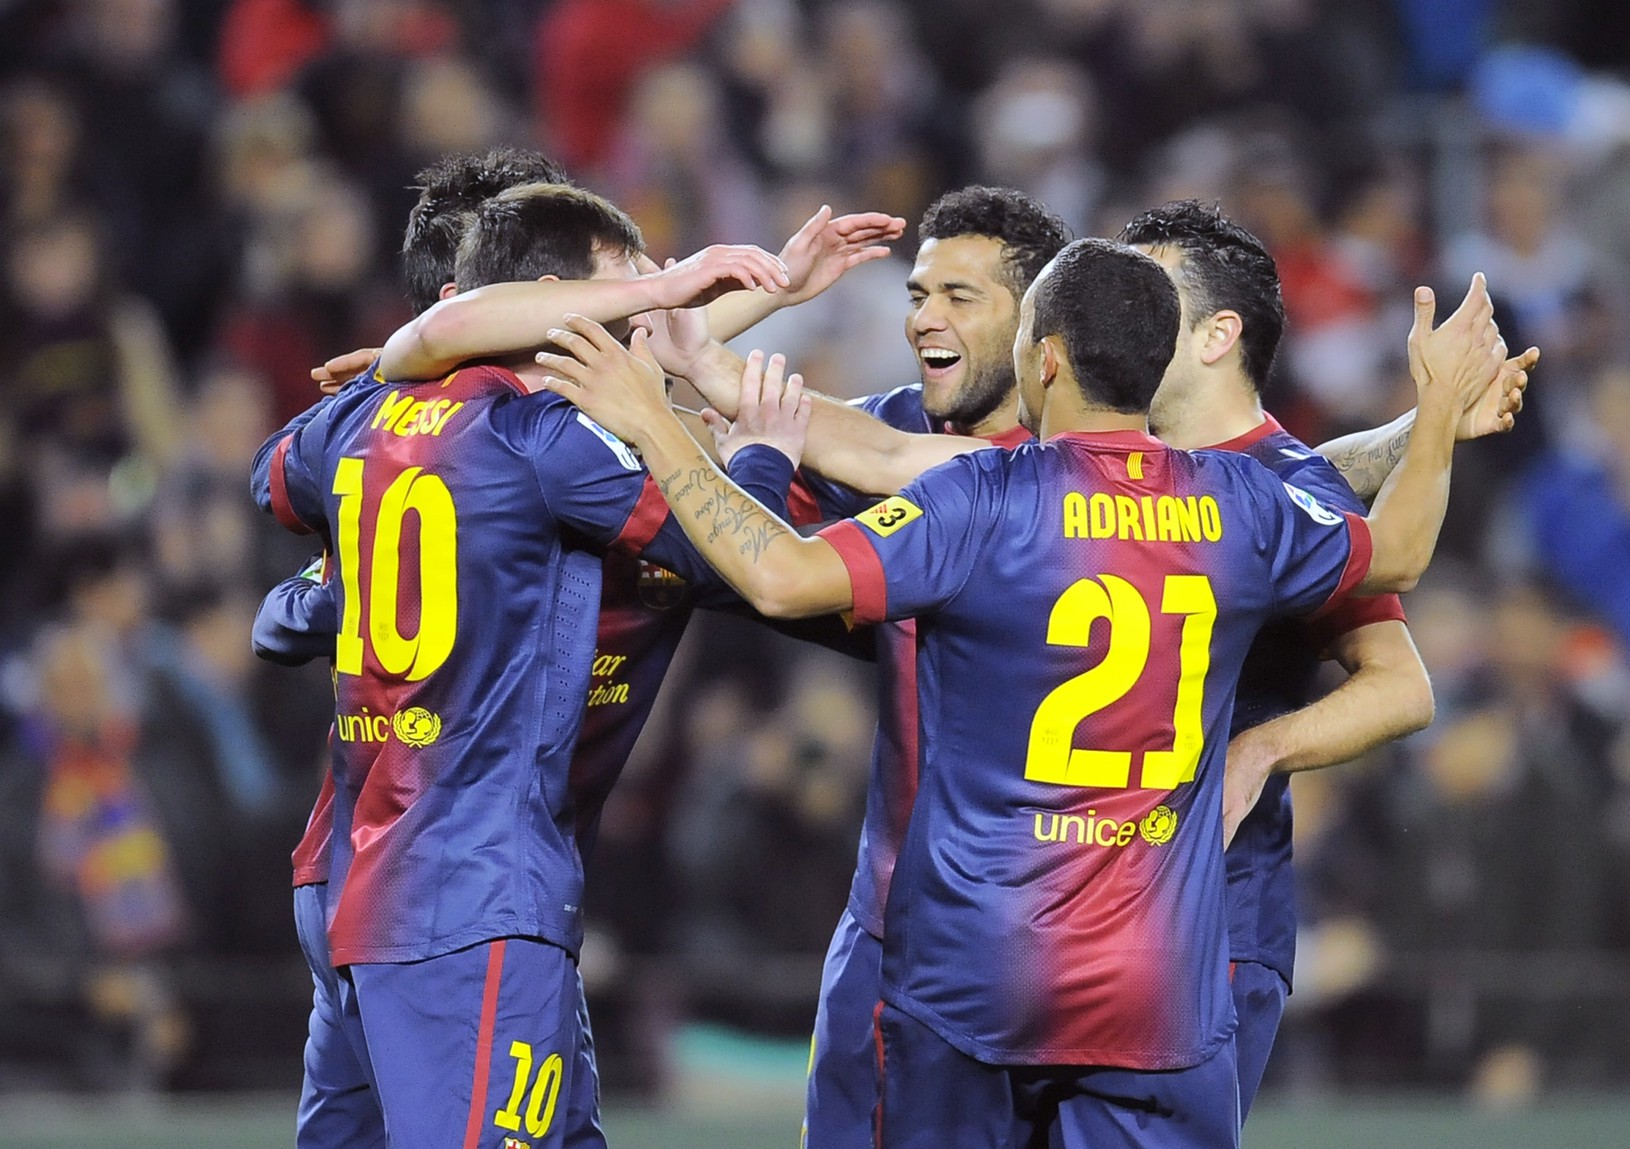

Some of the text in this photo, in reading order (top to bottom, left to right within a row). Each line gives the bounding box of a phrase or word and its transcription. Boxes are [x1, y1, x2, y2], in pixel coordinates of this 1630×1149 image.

[371, 390, 464, 437] MESSI
[877, 507, 907, 528] 3
[1063, 491, 1223, 544] ADRIANO
[332, 457, 458, 682] 10
[587, 680, 630, 707] tion
[1024, 573, 1218, 791] 21
[337, 706, 389, 742] unic
[1033, 809, 1137, 847] unice
[494, 1040, 563, 1139] 10
